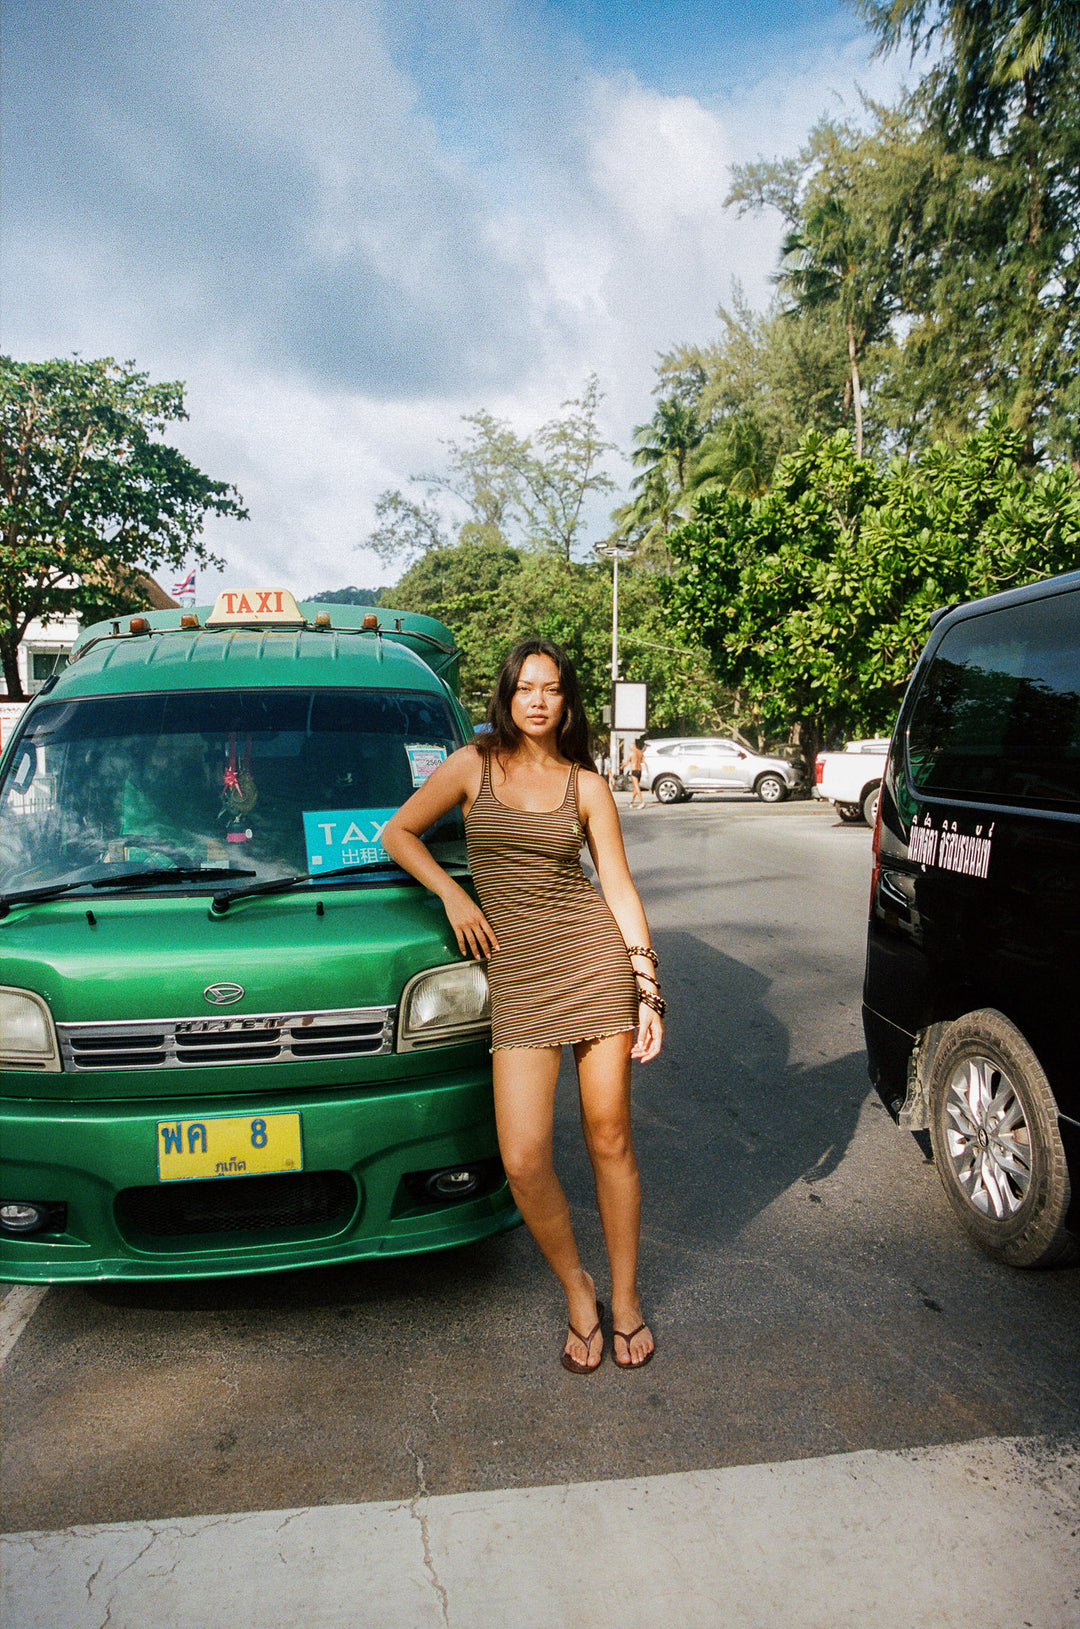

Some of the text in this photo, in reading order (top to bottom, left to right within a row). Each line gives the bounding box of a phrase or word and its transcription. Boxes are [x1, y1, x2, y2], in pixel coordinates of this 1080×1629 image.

[221, 591, 284, 614] TAXI
[317, 820, 389, 845] TAX
[174, 1016, 280, 1032] HIJET
[250, 1118, 268, 1149] 8
[215, 1156, 246, 1177] ภูเก็ต
